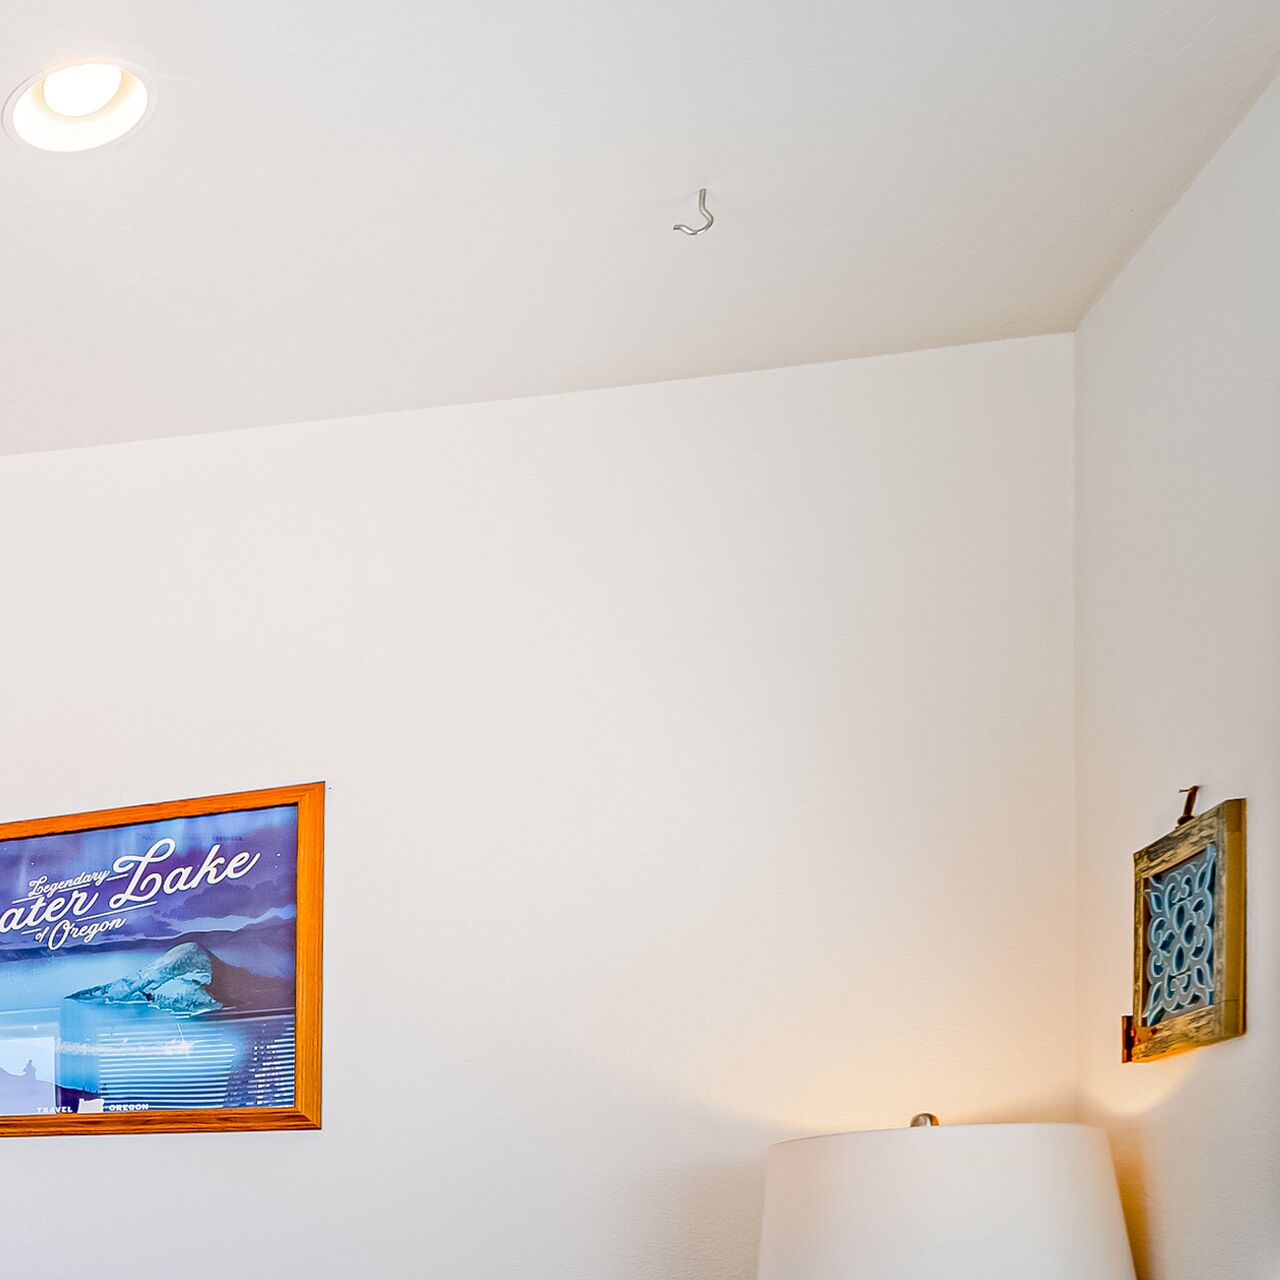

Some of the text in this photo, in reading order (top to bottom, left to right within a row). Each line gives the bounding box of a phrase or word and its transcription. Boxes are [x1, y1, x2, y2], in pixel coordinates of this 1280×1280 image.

[28, 869, 111, 897] Legendary
[109, 838, 261, 909] Lake
[35, 918, 128, 951] of Oregon
[36, 1103, 149, 1114] TRAVEL OREGON
